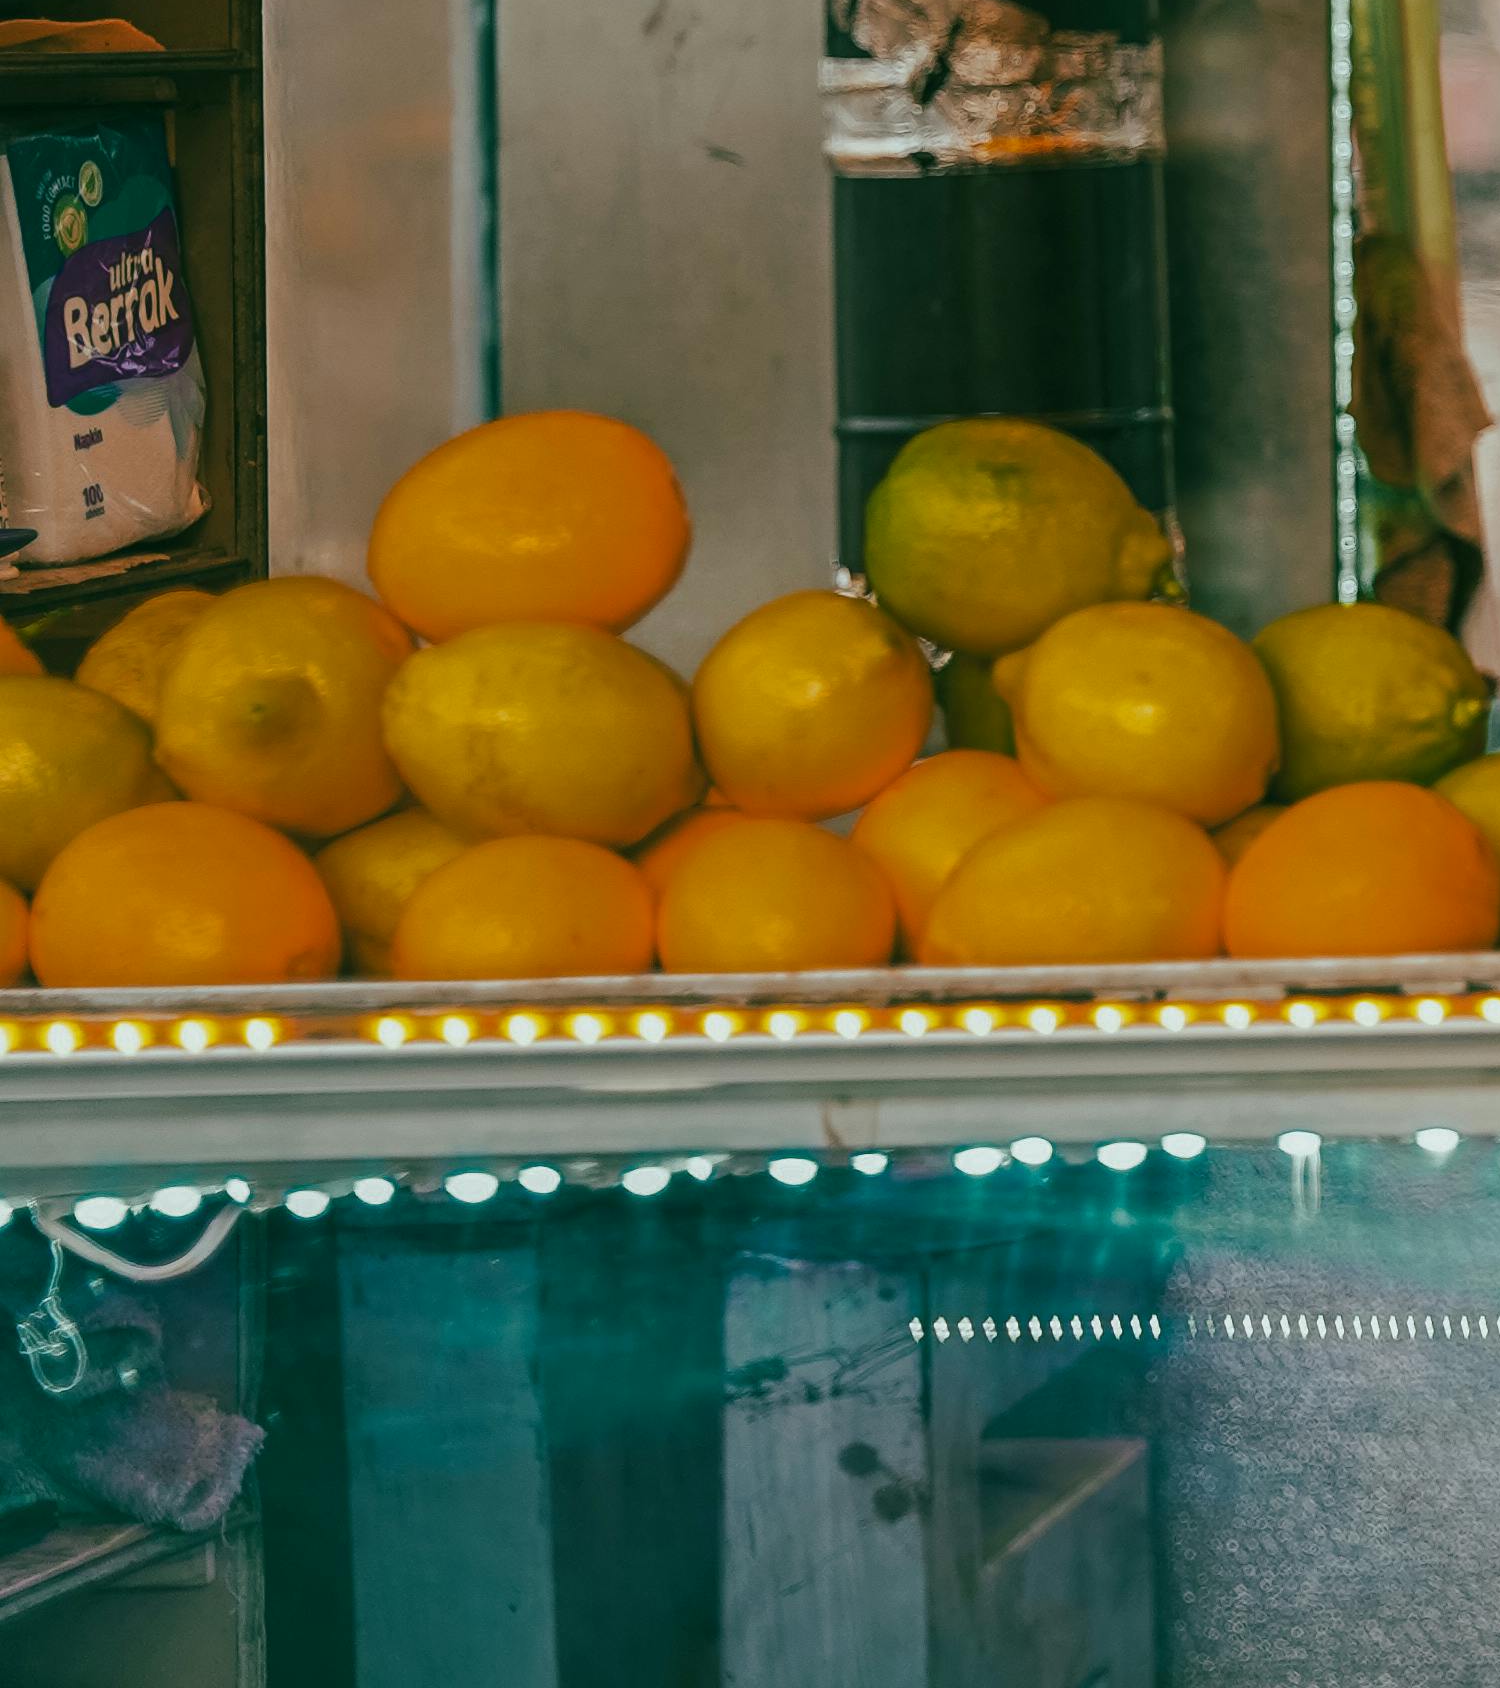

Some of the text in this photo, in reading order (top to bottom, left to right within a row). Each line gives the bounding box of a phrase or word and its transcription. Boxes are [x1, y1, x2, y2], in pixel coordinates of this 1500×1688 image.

[110, 247, 153, 291] ultra
[64, 257, 179, 369] Berrak
[83, 483, 104, 507] 100
